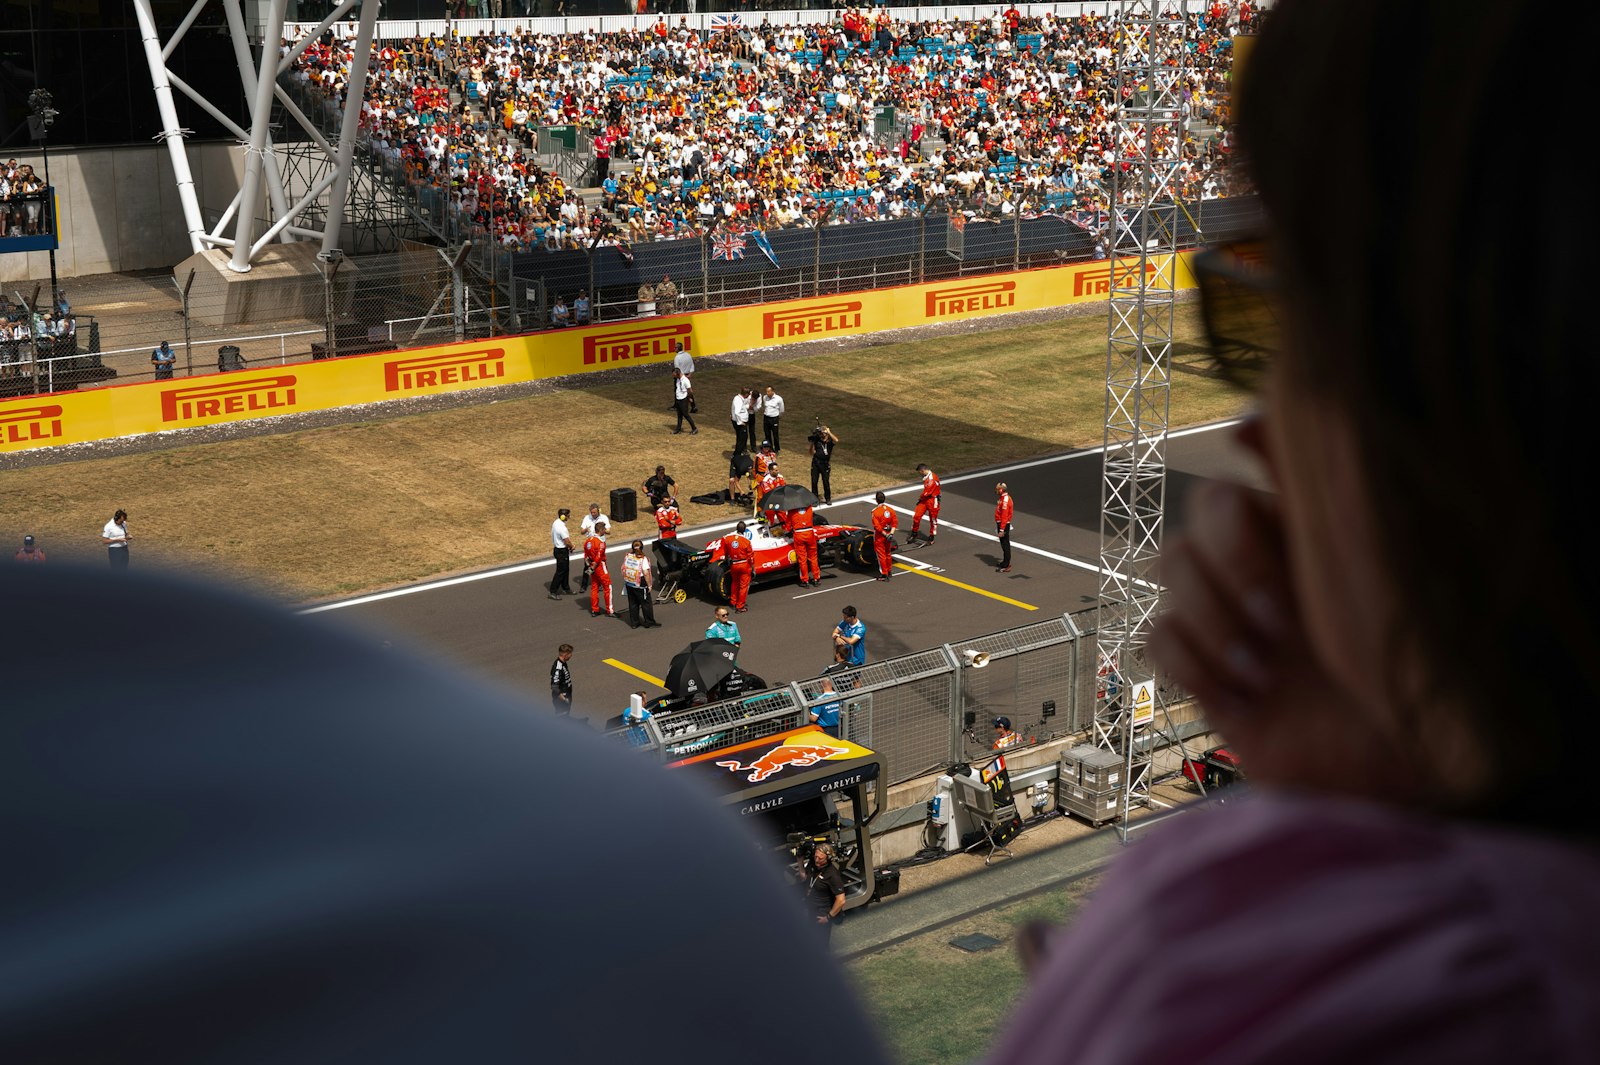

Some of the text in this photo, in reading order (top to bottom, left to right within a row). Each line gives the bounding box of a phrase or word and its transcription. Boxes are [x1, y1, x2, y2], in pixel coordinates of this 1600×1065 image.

[925, 281, 1016, 317] PIRELLI
[762, 301, 862, 340] PIRELLI
[583, 323, 693, 365] PIRELLI
[384, 348, 505, 392] PIRELLI
[161, 374, 297, 422] PIRELLI
[706, 539, 722, 551] 44
[820, 775, 861, 793] CARLYLE
[741, 797, 783, 815] CARLYLE
